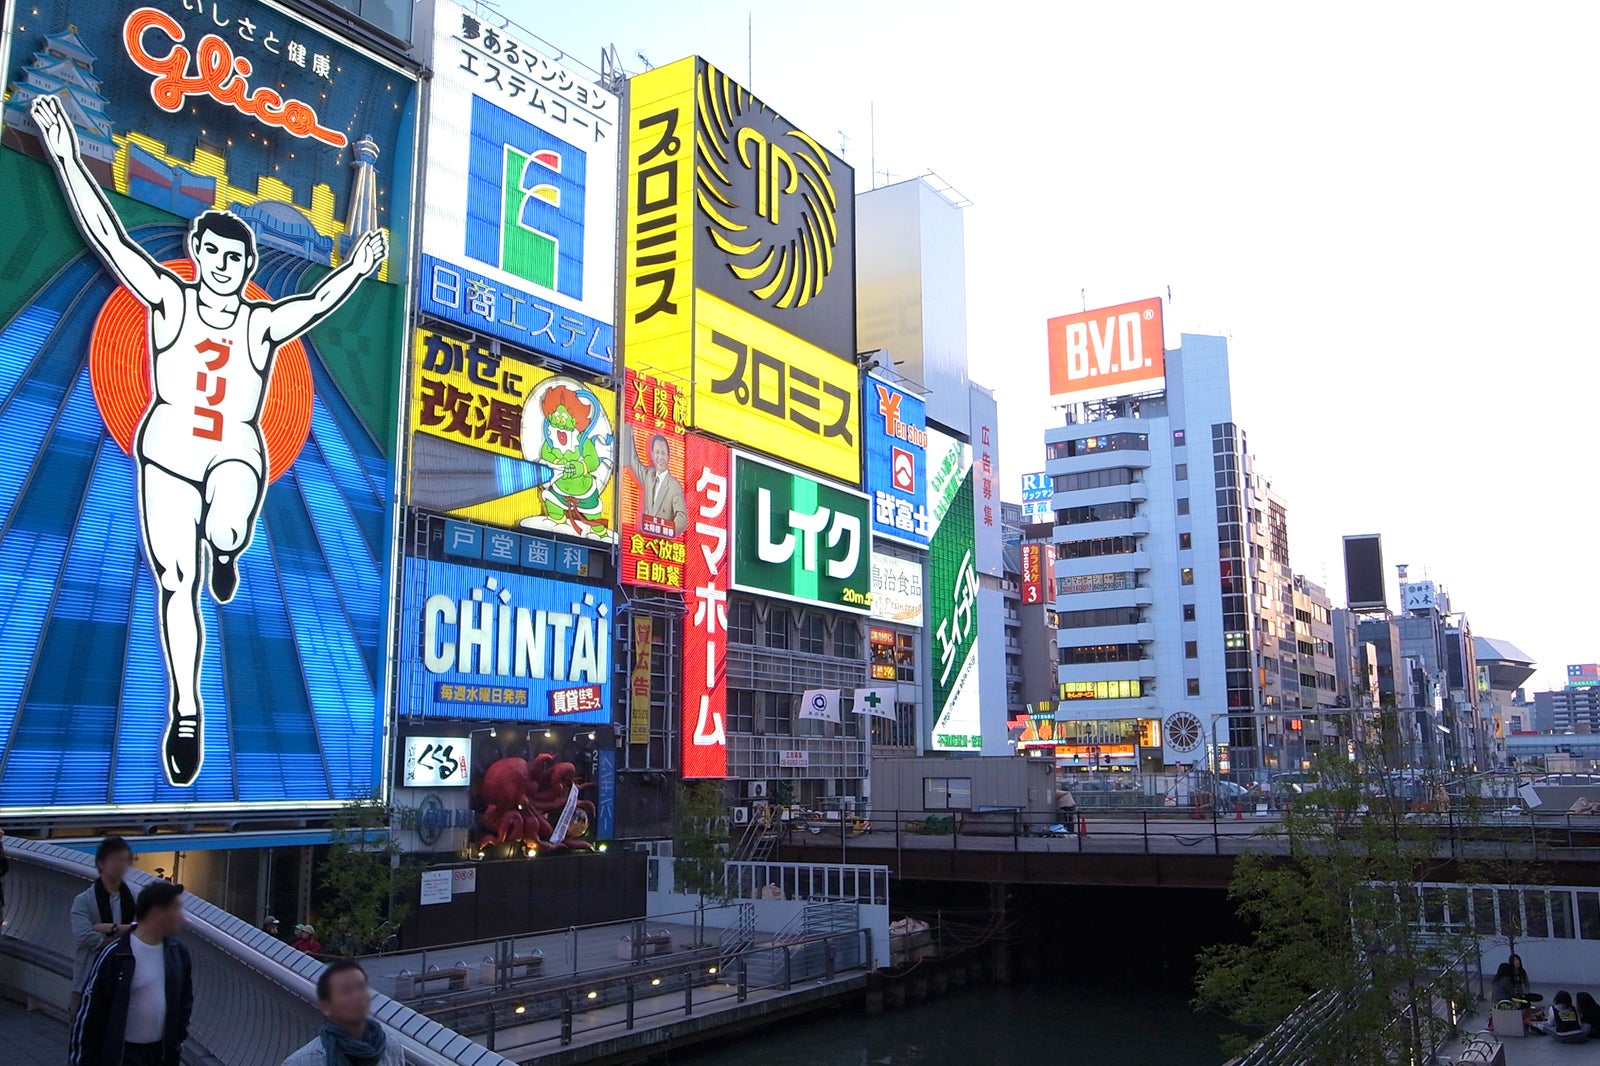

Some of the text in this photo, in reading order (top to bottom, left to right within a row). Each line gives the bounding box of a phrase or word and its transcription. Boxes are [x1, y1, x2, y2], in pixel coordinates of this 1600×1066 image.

[461, 13, 606, 110] 夢あるマンション
[460, 50, 605, 142] エステムコート
[635, 108, 681, 324] プロミス
[432, 264, 613, 364] 日商エステム
[193, 338, 233, 442] グリコ
[711, 330, 853, 448] プロミス
[420, 377, 522, 450] 改源
[908, 424, 928, 448] shop
[981, 425, 993, 527] 広告募集
[757, 486, 861, 580] レイク
[876, 490, 929, 537] 武富士
[452, 526, 582, 571] 戸堂歯科
[630, 533, 686, 563] 食べ放題
[1030, 545, 1039, 583] カラオケ
[636, 559, 680, 587] 自助餐
[843, 587, 864, 605] 20m
[1027, 585, 1037, 602] 3
[692, 466, 727, 746] タマホーム
[424, 588, 608, 684] CHINTAI
[440, 684, 527, 705] 毎週水曜日発売
[553, 690, 579, 714] 賃貸
[578, 688, 593, 700] 住宅
[579, 697, 601, 710] ニュース
[417, 744, 459, 780] くくる
